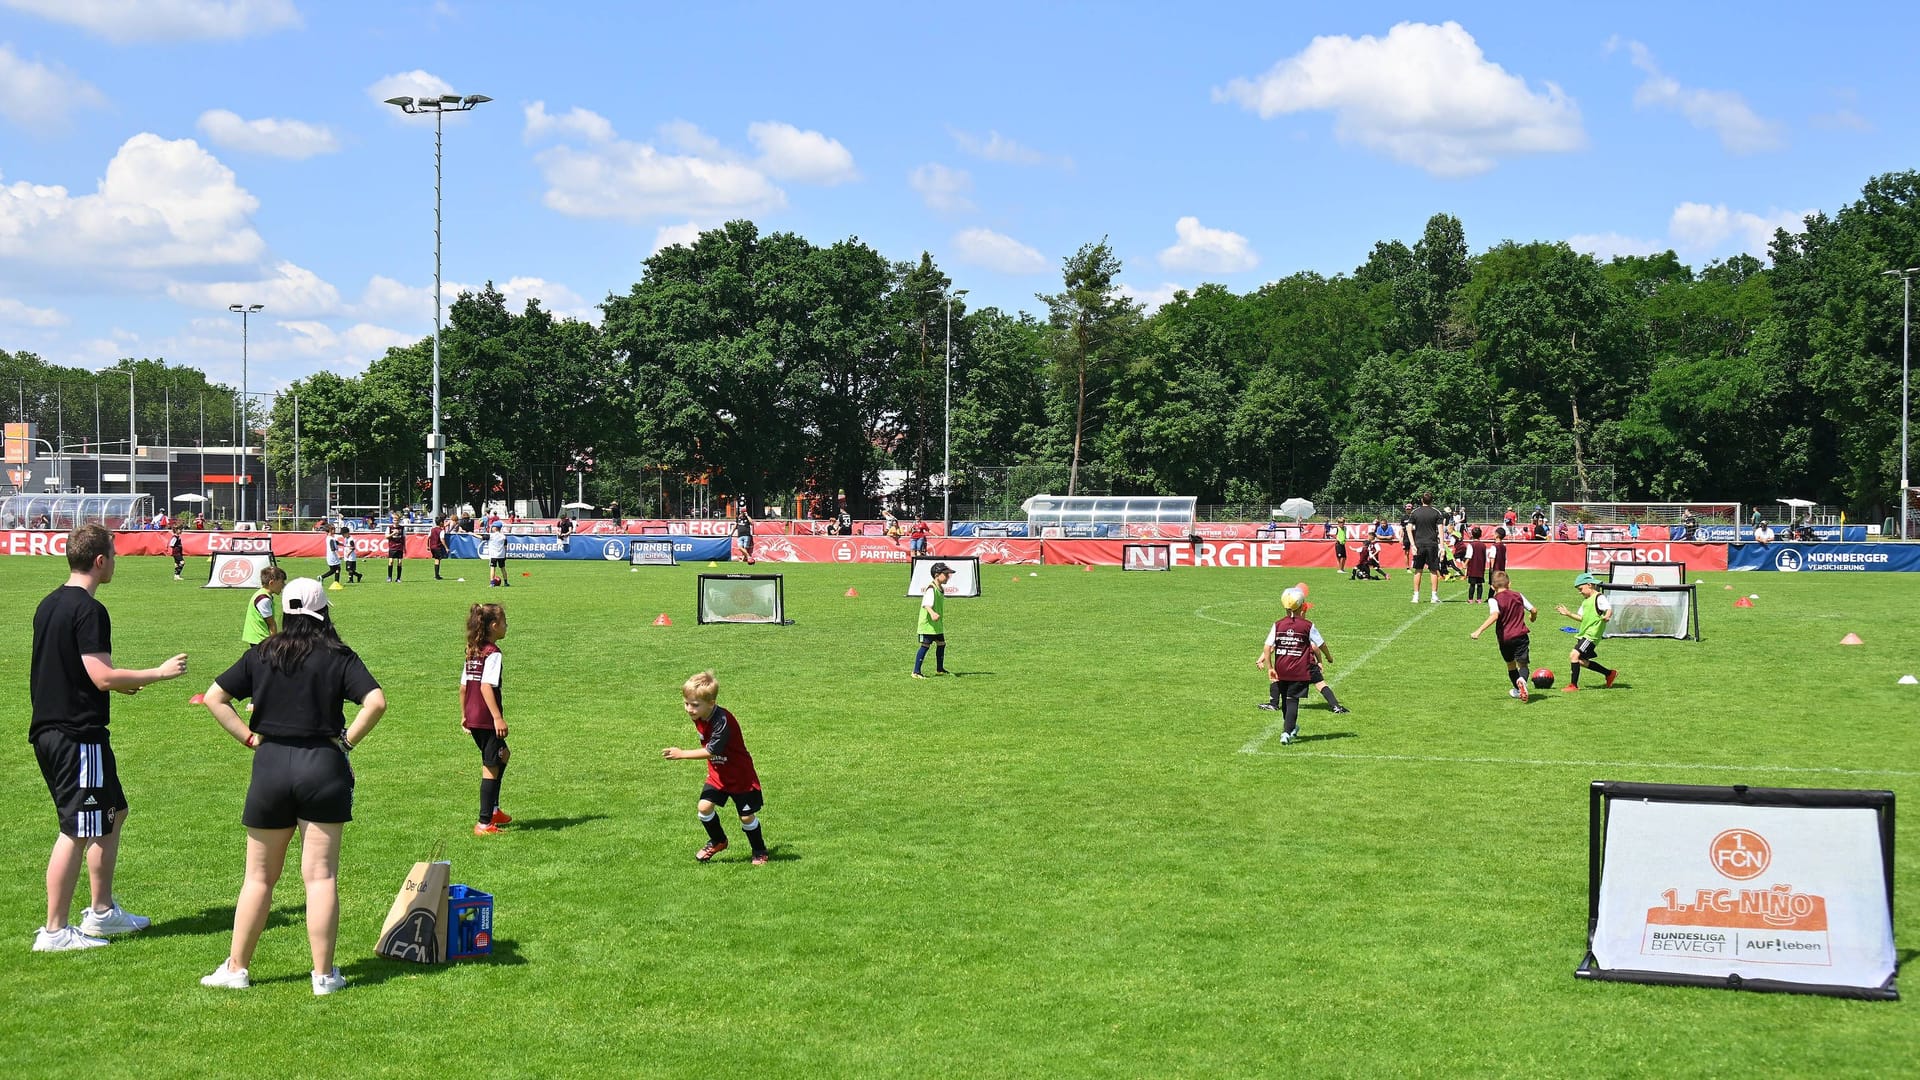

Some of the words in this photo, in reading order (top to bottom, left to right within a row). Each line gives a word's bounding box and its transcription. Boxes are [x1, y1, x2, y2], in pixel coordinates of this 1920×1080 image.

[860, 550, 907, 559] PARTNER
[1588, 543, 1672, 564] Exasol
[1807, 552, 1888, 563] NÜRNBERGER
[222, 569, 248, 579] FCN
[1733, 833, 1746, 849] 1.
[1718, 849, 1763, 868] FCN
[406, 879, 417, 891] Der
[1662, 888, 1687, 912] 1.
[1694, 888, 1731, 913] FC
[1739, 884, 1814, 918] NIÑO
[414, 916, 423, 943] 1.
[1653, 931, 1726, 942] BUNDESLIGA
[1651, 940, 1727, 953] BEWEGT
